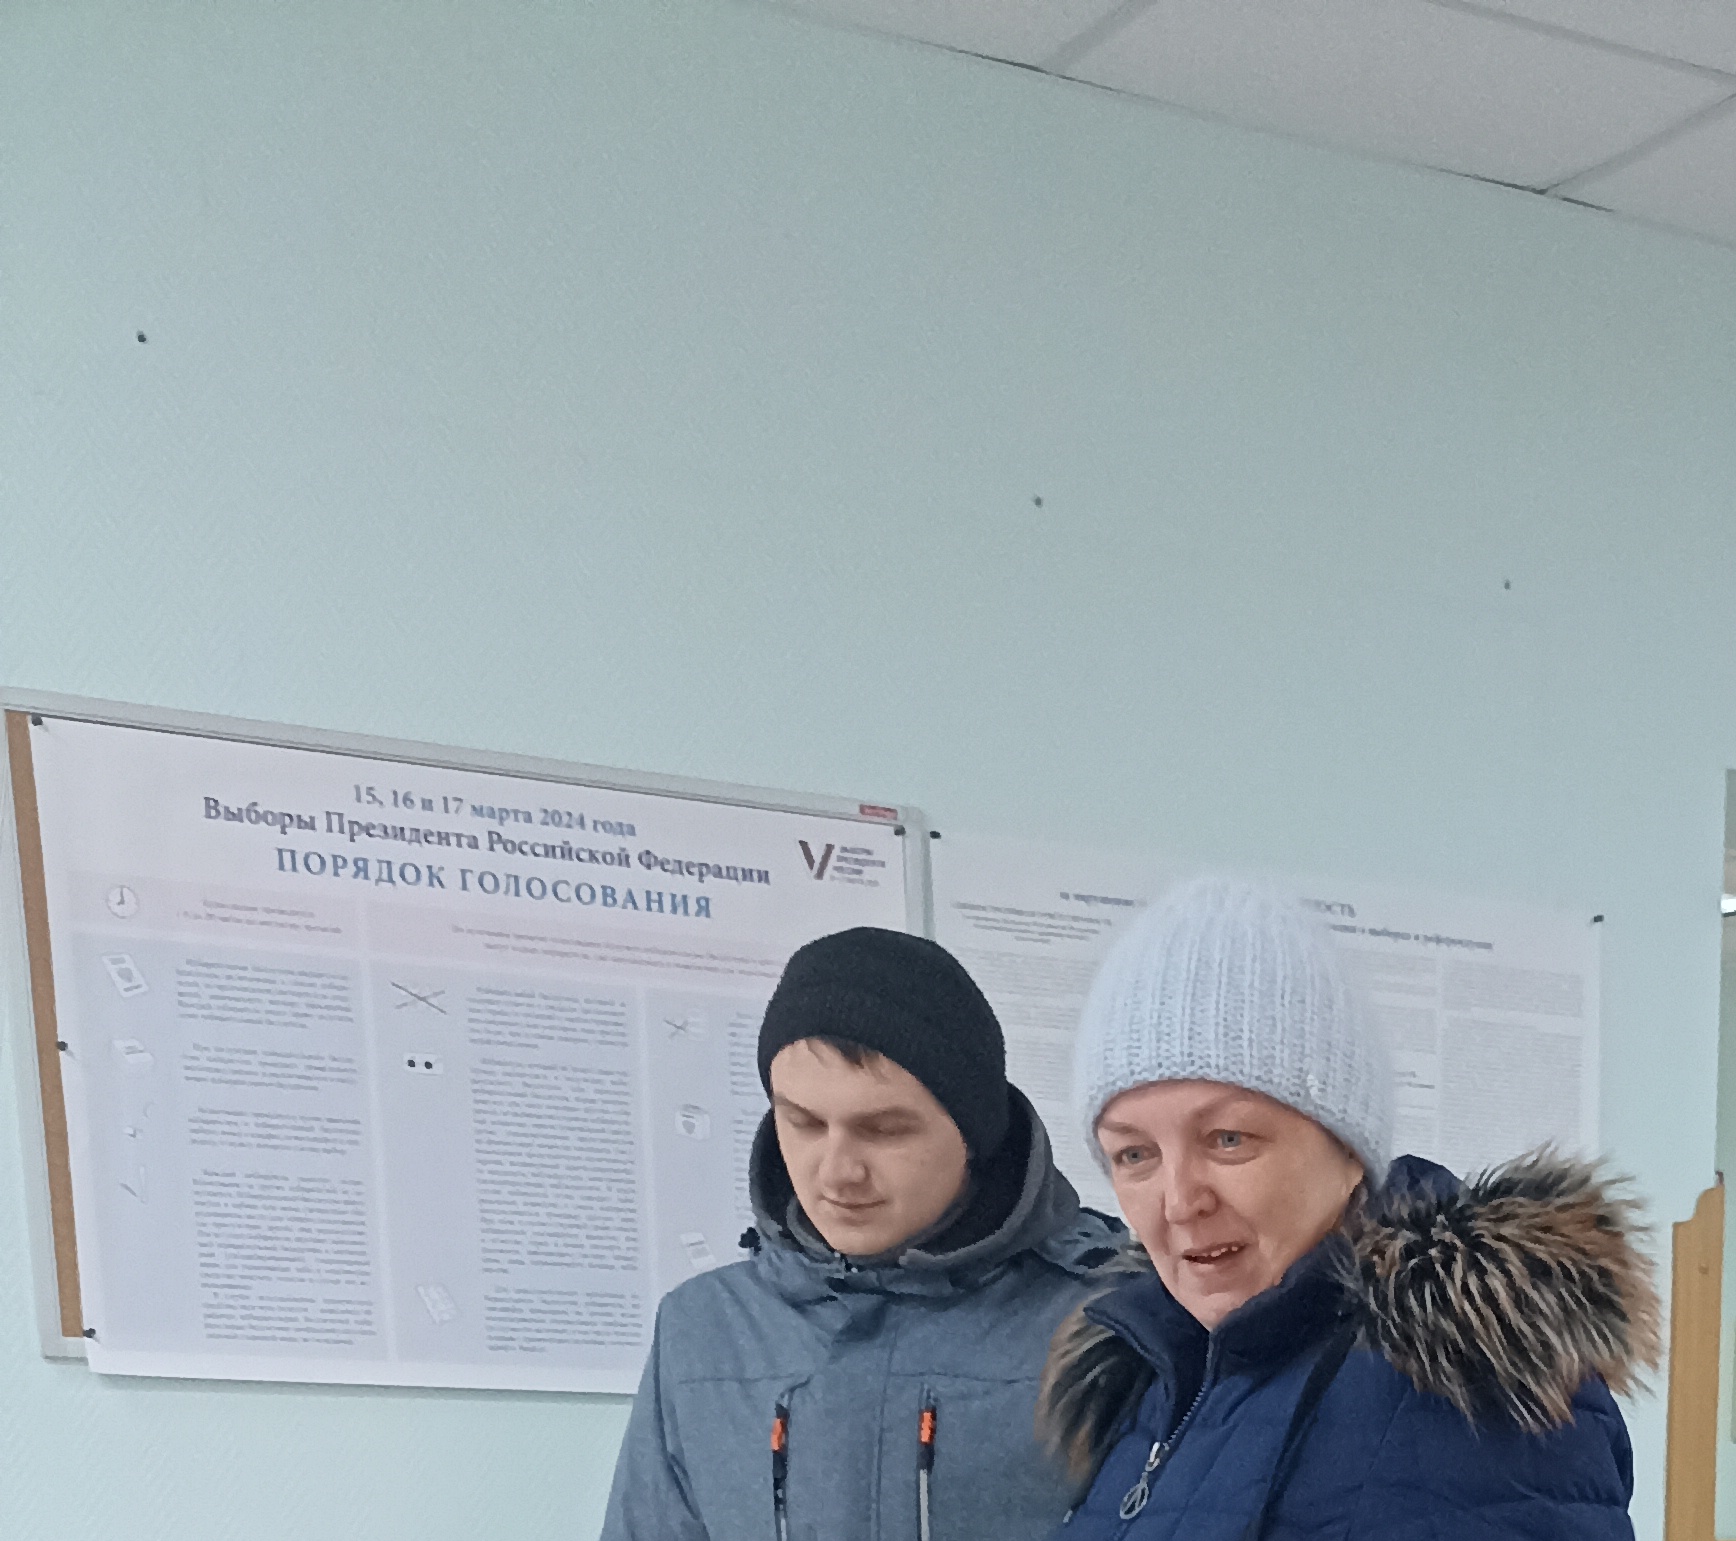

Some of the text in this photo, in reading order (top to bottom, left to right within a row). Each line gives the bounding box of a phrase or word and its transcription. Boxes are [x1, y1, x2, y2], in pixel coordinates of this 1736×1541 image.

[203, 796, 771, 885] Выборы Президента Российской Федерации
[353, 783, 637, 838] 15, 16 и 17 марта 2024 года
[276, 847, 712, 919] ПОРЯДОК ГОЛОСОВАНИЯ
